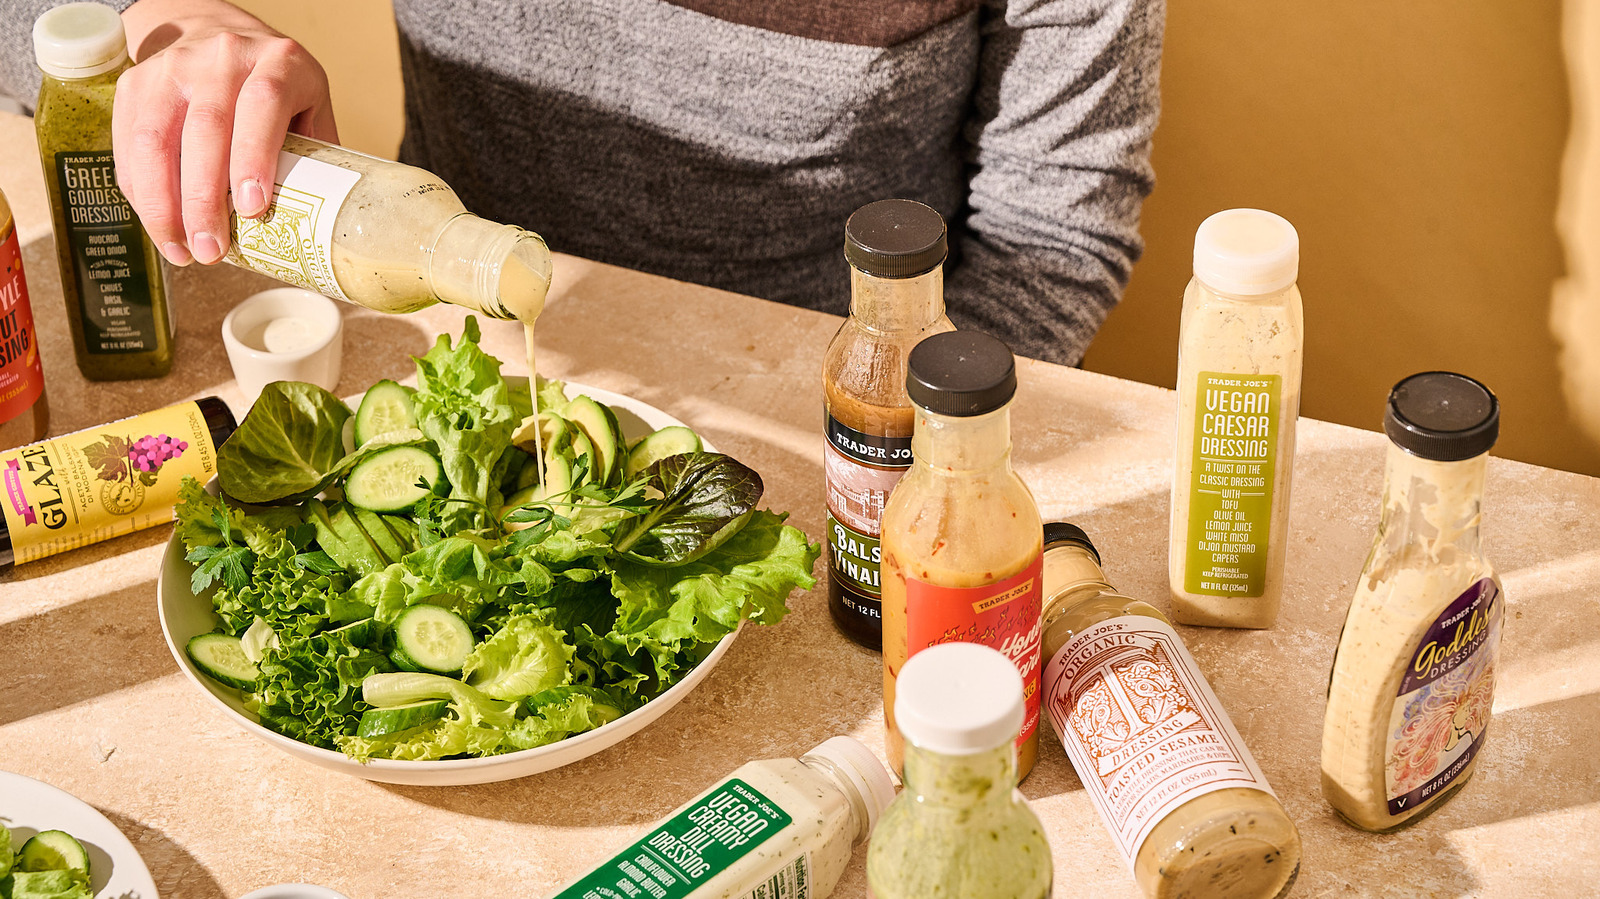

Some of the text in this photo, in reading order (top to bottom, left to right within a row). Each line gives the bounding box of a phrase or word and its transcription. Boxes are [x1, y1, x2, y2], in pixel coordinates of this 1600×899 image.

[71, 204, 131, 224] DRESSING
[85, 245, 127, 257] GREEN ONION
[88, 234, 120, 245] AVOCADO
[317, 244, 332, 280] TRADER
[88, 268, 131, 280] LEMON JUICE
[0, 274, 21, 311] YLE
[100, 283, 123, 293] CHIVES
[103, 295, 122, 305] BASIL
[107, 306, 131, 317] GARLIC
[0, 308, 18, 340] UT
[0, 328, 28, 368] SING
[1207, 377, 1241, 387] TRADER
[1205, 388, 1270, 414] VEGAN
[1202, 413, 1270, 437] CAESAR
[836, 432, 914, 459] TRADER JO
[1201, 436, 1268, 458] DRESSING
[77, 459, 91, 493] MODENA
[202, 461, 213, 473] NET
[1205, 462, 1261, 475] A TWIST ON THE
[21, 445, 67, 530] GLAZE
[1199, 474, 1265, 487] CLASSIC DRESSING
[87, 494, 94, 504] DI
[1221, 489, 1240, 499] WITH
[1221, 499, 1239, 510] TOFU
[1205, 520, 1252, 532] LEMON JUICE
[1213, 510, 1246, 521] OLIVE OIL
[834, 524, 880, 563] BALS
[1198, 541, 1256, 554] DIJON MUSTARD
[1205, 531, 1249, 543] WHITE MISO
[831, 542, 880, 587] VINAI
[1212, 553, 1240, 564] CAPERS
[1200, 582, 1210, 590] NET
[1216, 582, 1221, 591] FL
[1222, 583, 1229, 591] OZ
[842, 595, 881, 618] NET 12 FL
[978, 593, 1010, 610] TRADER
[1441, 607, 1470, 629] TRADER
[1058, 633, 1091, 666] TRADER
[1093, 623, 1123, 636] JOE'S
[1430, 630, 1487, 678] DRESSING
[1064, 634, 1136, 680] ORGANIC
[1112, 719, 1183, 766] DRESSING
[1108, 734, 1220, 804] TOASTED SESAME
[1141, 753, 1177, 779] DRESSING
[1178, 747, 1198, 758] THAT
[1160, 753, 1206, 774] MARINADES
[1421, 784, 1433, 797] NET
[1432, 781, 1437, 790] 8
[1437, 777, 1443, 787] FL
[1443, 771, 1451, 782] OZ
[732, 784, 780, 820] TRADER JOE'S
[1136, 805, 1149, 820] NET
[1149, 796, 1158, 807] 12
[708, 790, 769, 838] VEGAN
[688, 805, 750, 850] CREAMY
[679, 825, 716, 855] DILL
[648, 830, 711, 879] DRESSING
[617, 859, 667, 899] ALMOND BUTTER
[634, 853, 676, 888] CAULIFLOWER
[616, 877, 642, 899] GARLIC
